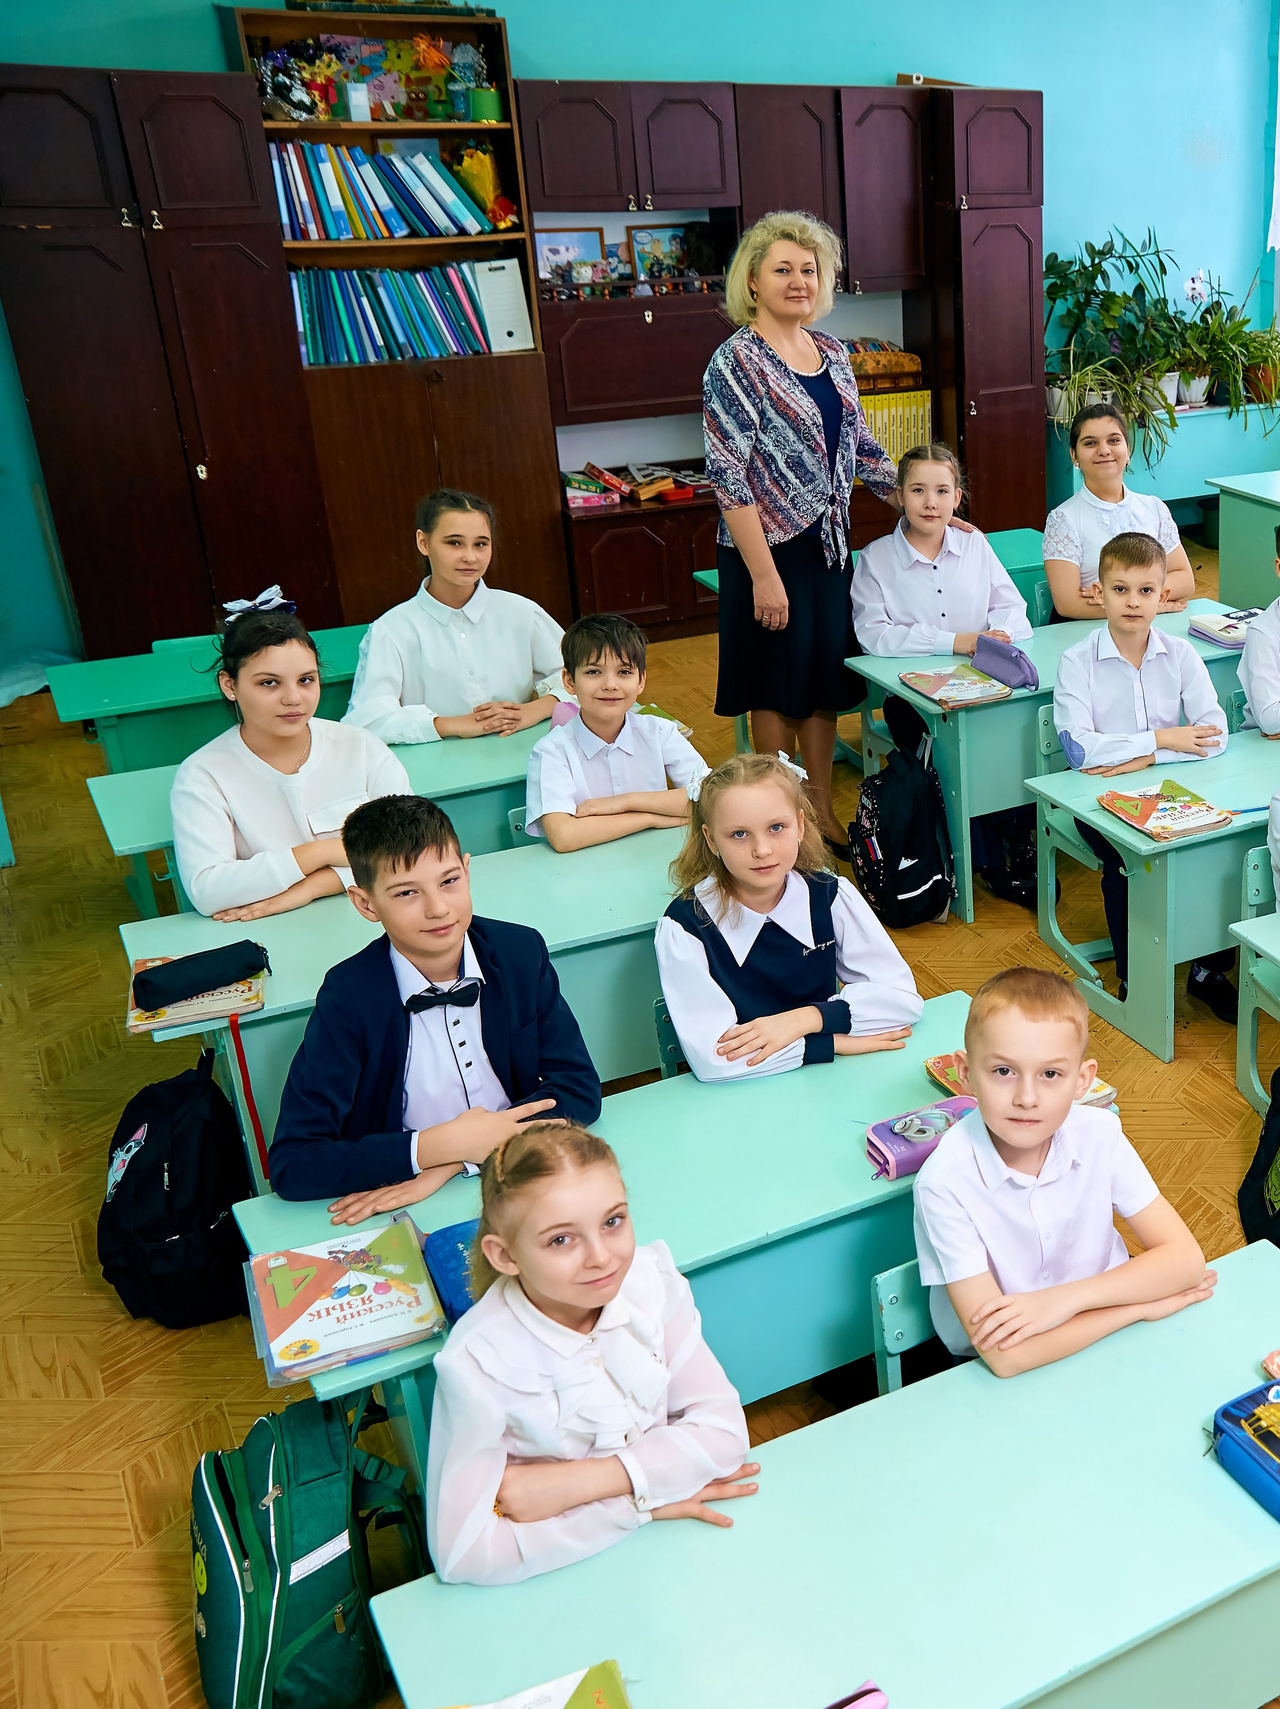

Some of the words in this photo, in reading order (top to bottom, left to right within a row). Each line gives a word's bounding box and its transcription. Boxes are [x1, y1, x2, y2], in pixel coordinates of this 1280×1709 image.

[264, 1265, 318, 1309] 4
[307, 1294, 374, 1322] язык
[335, 1294, 424, 1325] Русский
[592, 1688, 606, 1706] 2
